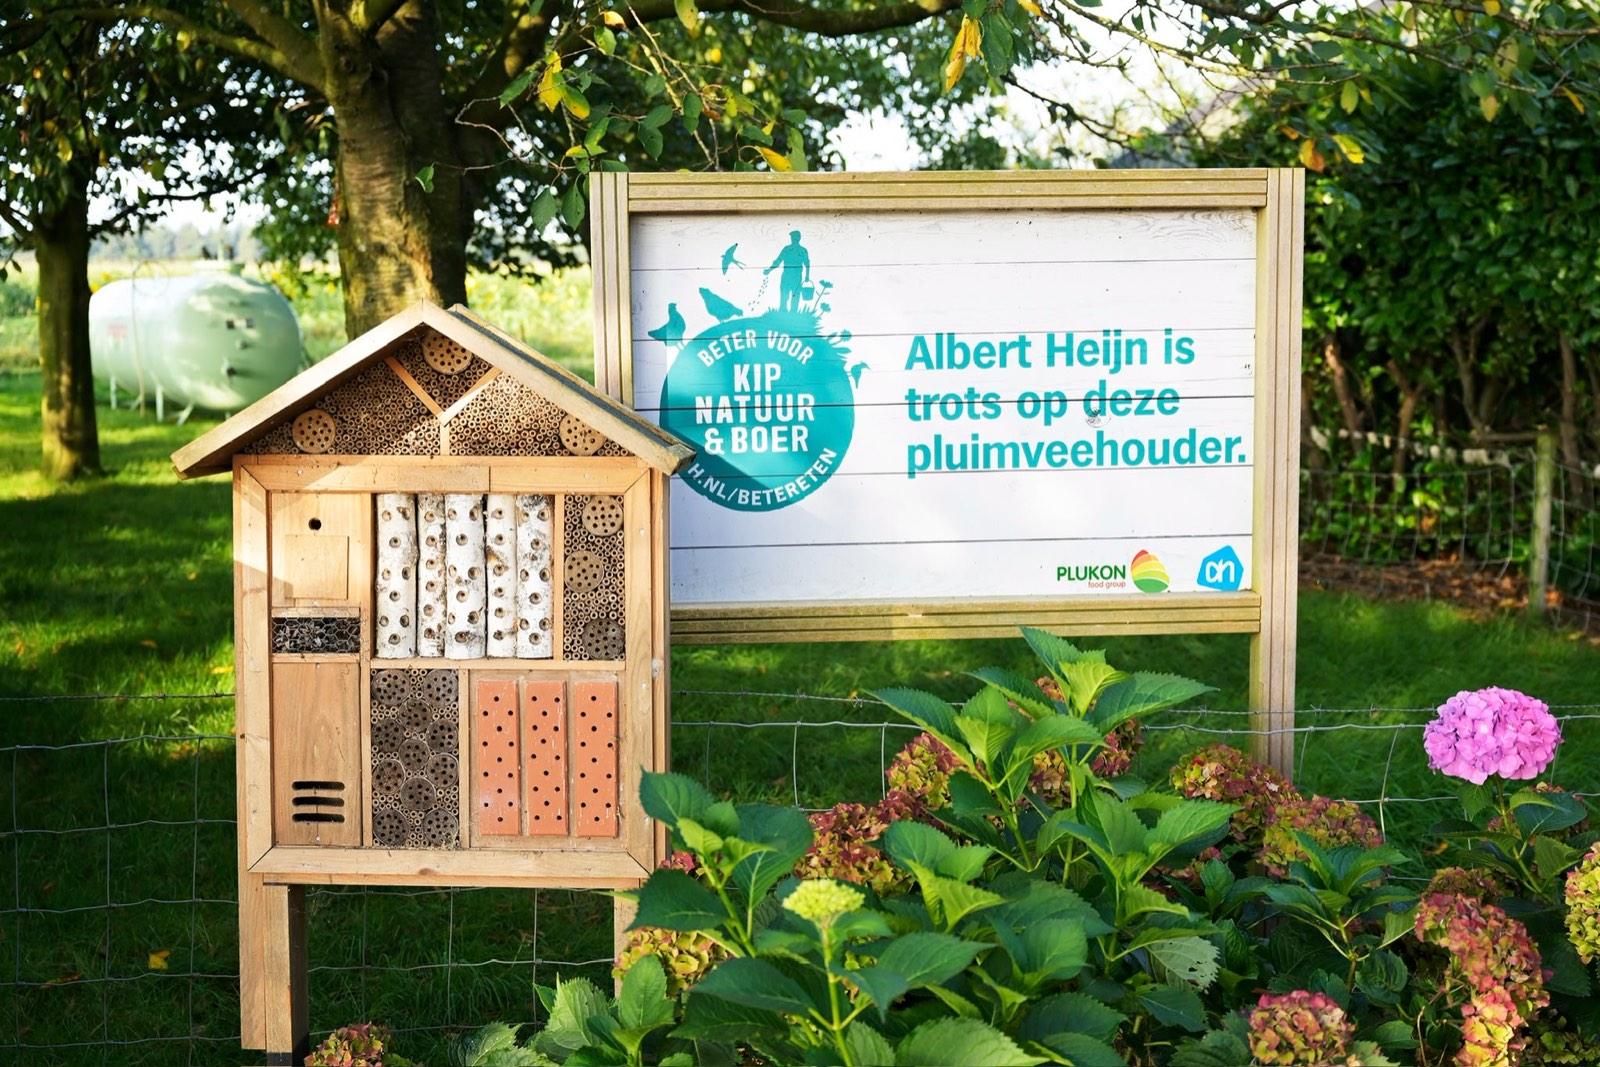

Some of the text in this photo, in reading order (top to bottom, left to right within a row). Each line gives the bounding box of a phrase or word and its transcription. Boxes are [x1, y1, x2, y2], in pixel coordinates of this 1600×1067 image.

[697, 329, 814, 368] BETER VOOR
[904, 328, 1195, 374] Albert Heijn is
[734, 363, 781, 392] KIP
[695, 394, 815, 424] NATUUR
[904, 379, 1180, 426] trots op deze
[704, 426, 809, 455] & BOER
[907, 428, 1246, 479] pluimveehouder.
[687, 447, 838, 506] H.NL/BETERETEN
[1057, 565, 1126, 581] PLUKON
[1106, 581, 1126, 589] group
